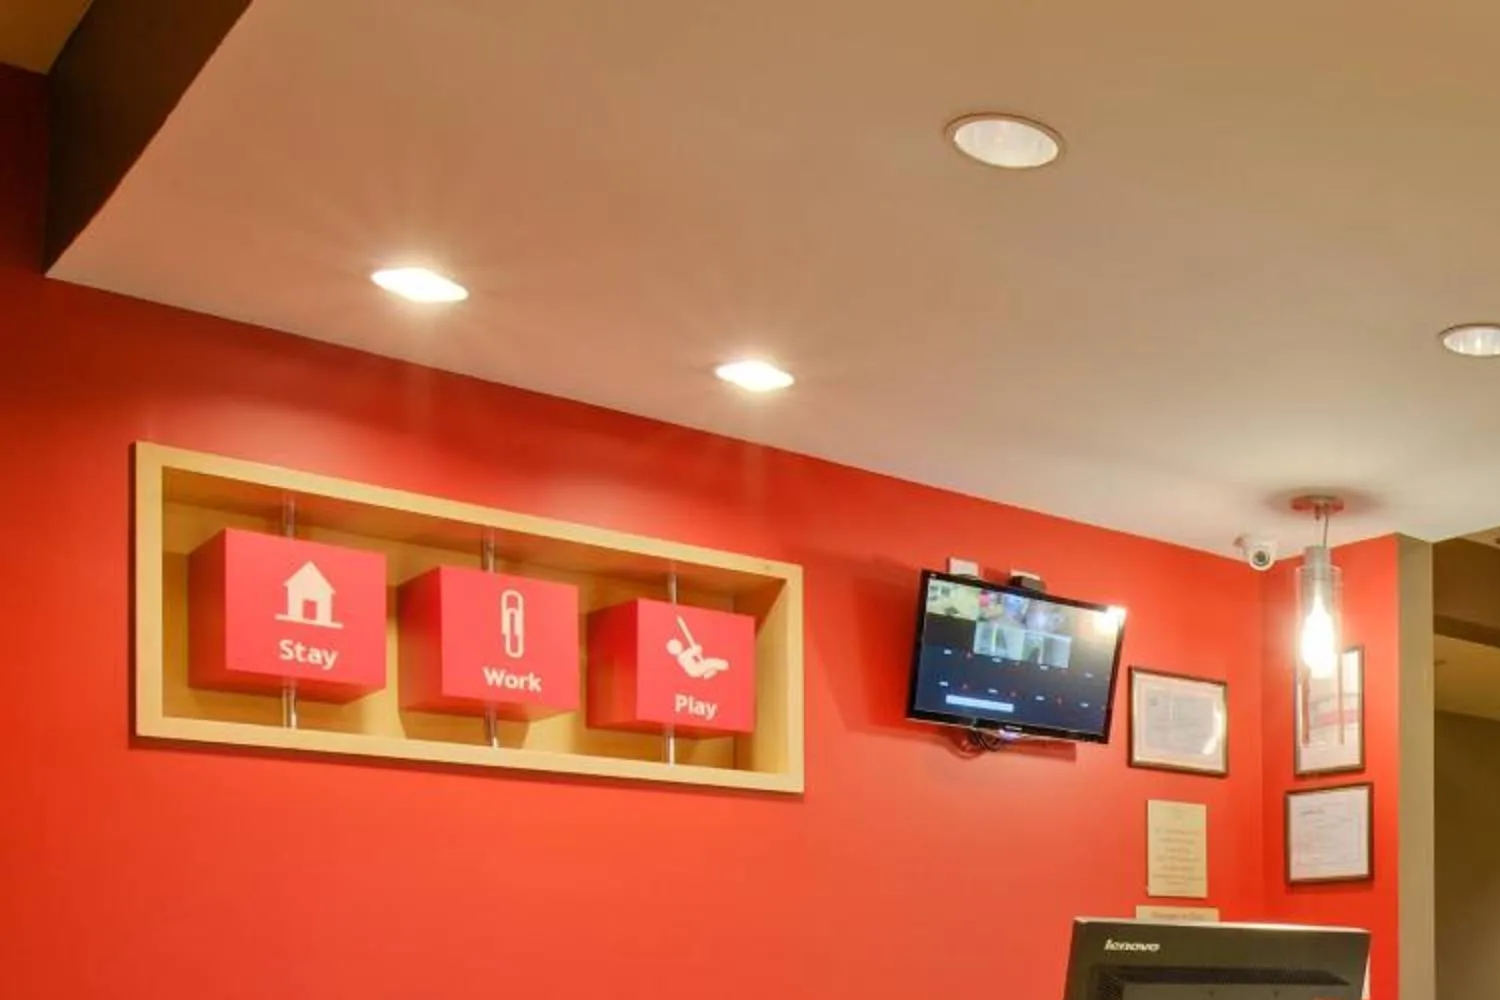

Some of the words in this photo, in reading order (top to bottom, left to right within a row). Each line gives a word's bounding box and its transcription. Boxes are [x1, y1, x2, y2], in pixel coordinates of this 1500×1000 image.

[278, 638, 338, 671] Stay
[482, 665, 542, 692] Work
[674, 693, 718, 720] Play
[1103, 938, 1160, 952] lenovo
